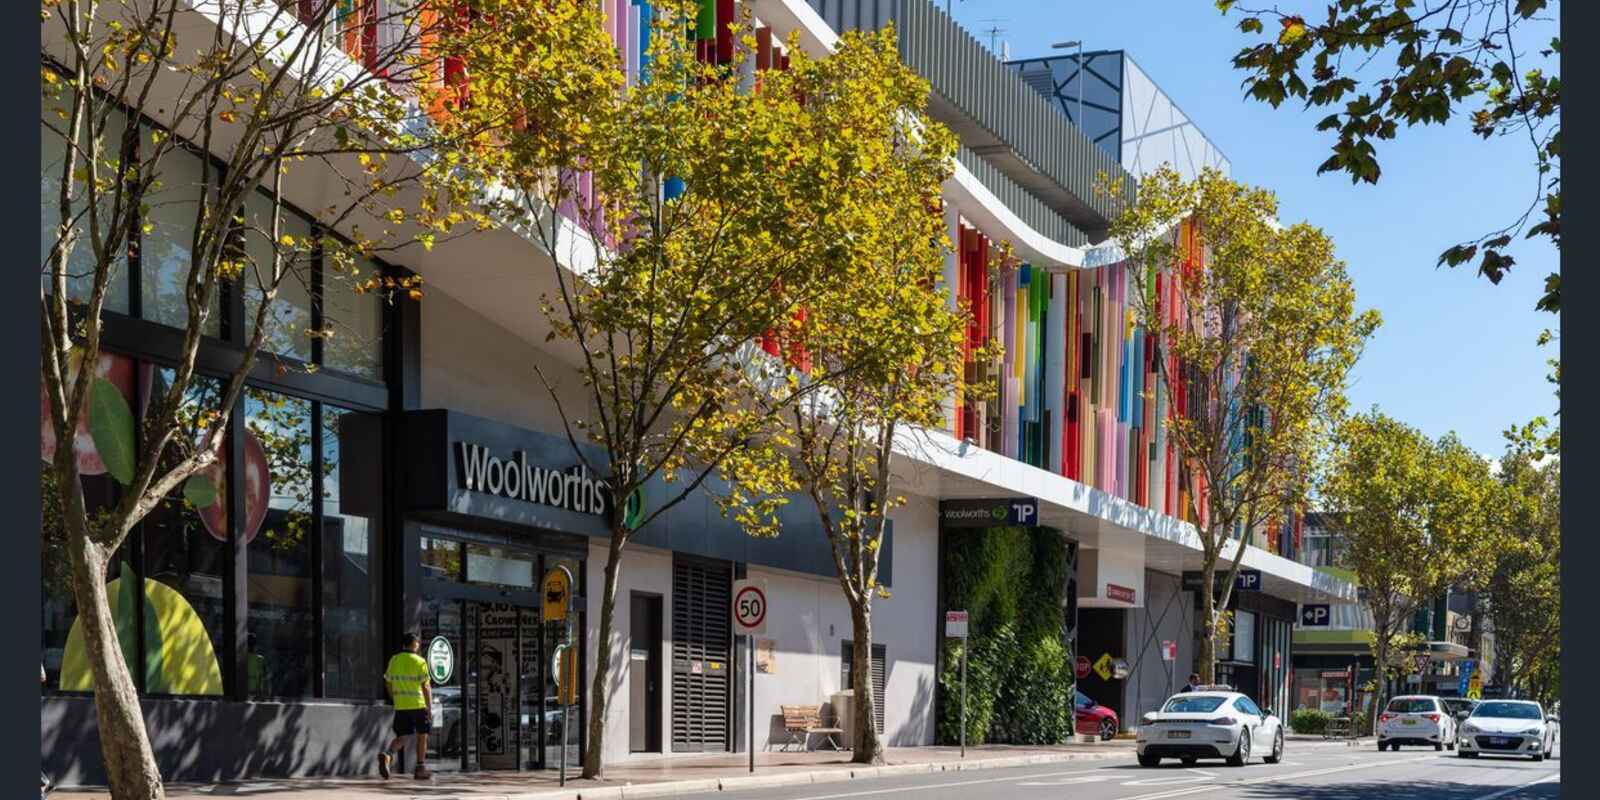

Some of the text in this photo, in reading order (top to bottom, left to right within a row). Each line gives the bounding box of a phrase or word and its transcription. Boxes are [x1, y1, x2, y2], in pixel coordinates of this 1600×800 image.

[459, 440, 605, 515] Woolworths
[945, 508, 991, 520] Woolworths
[740, 600, 760, 617] 50
[1314, 607, 1326, 624] P
